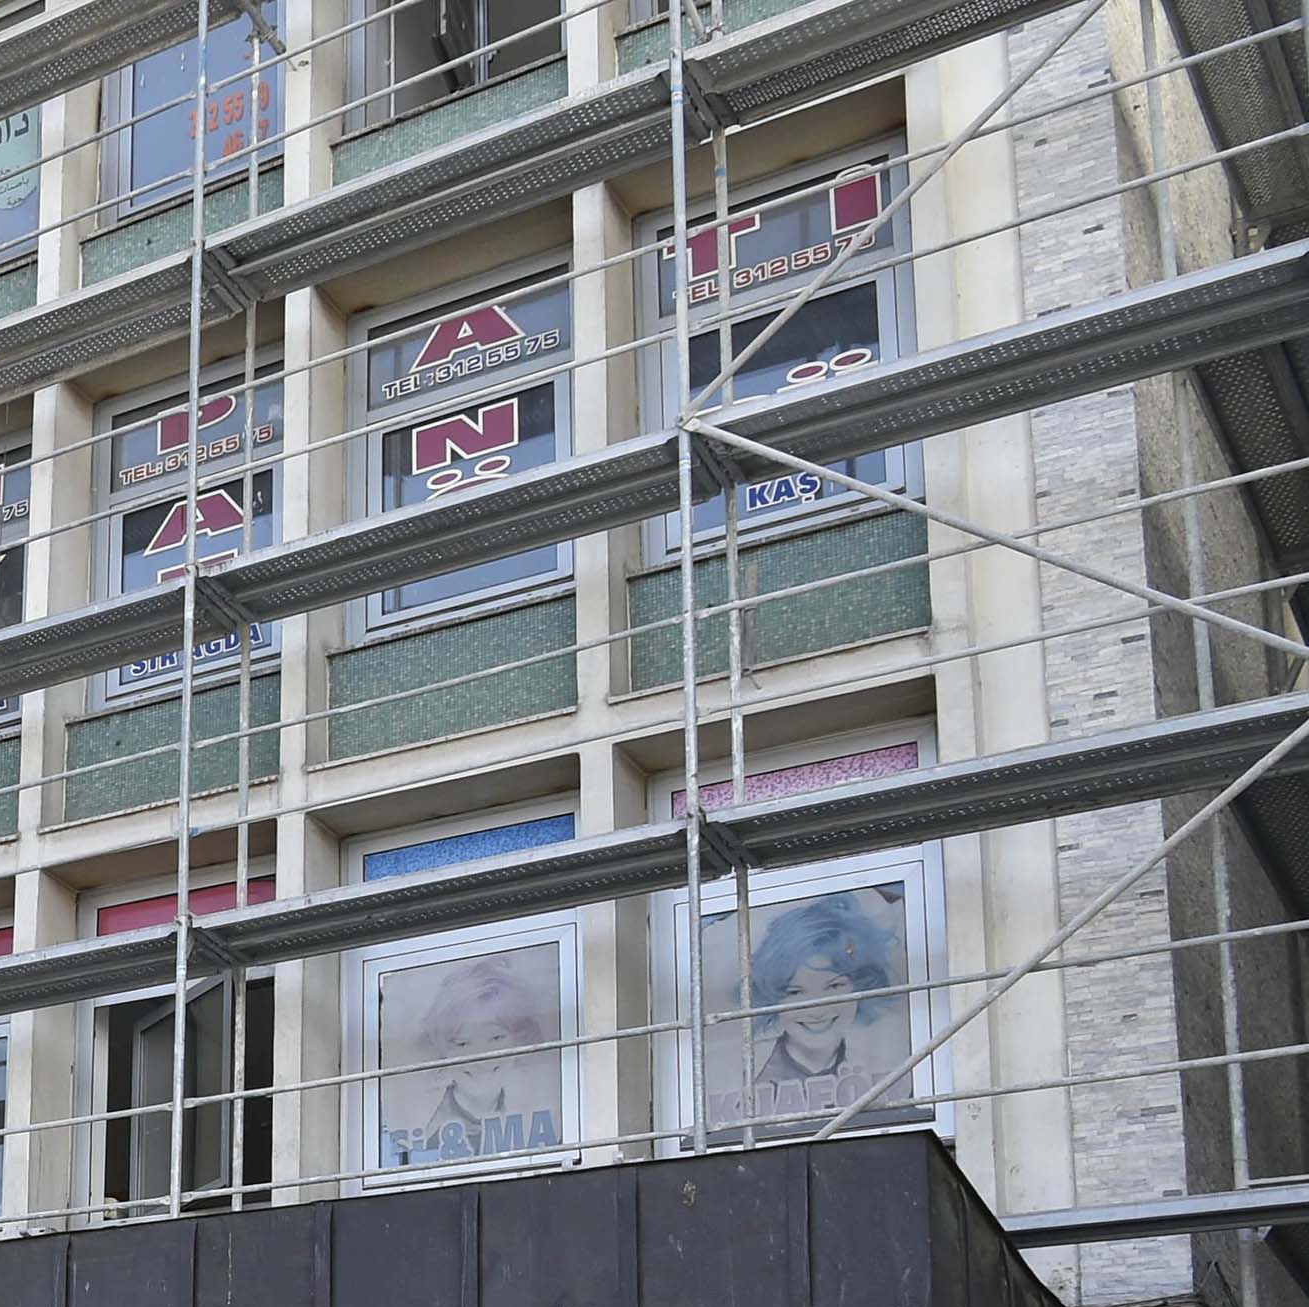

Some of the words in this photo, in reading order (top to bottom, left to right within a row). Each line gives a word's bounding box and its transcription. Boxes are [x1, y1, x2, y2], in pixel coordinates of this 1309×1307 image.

[733, 256, 788, 289] 312
[791, 247, 831, 277] 55
[435, 354, 484, 384] 312
[486, 343, 521, 370] 55
[525, 329, 561, 355] 75
[208, 433, 240, 458] 55
[2, 499, 30, 521] 75
[746, 471, 821, 512] KAŞ
